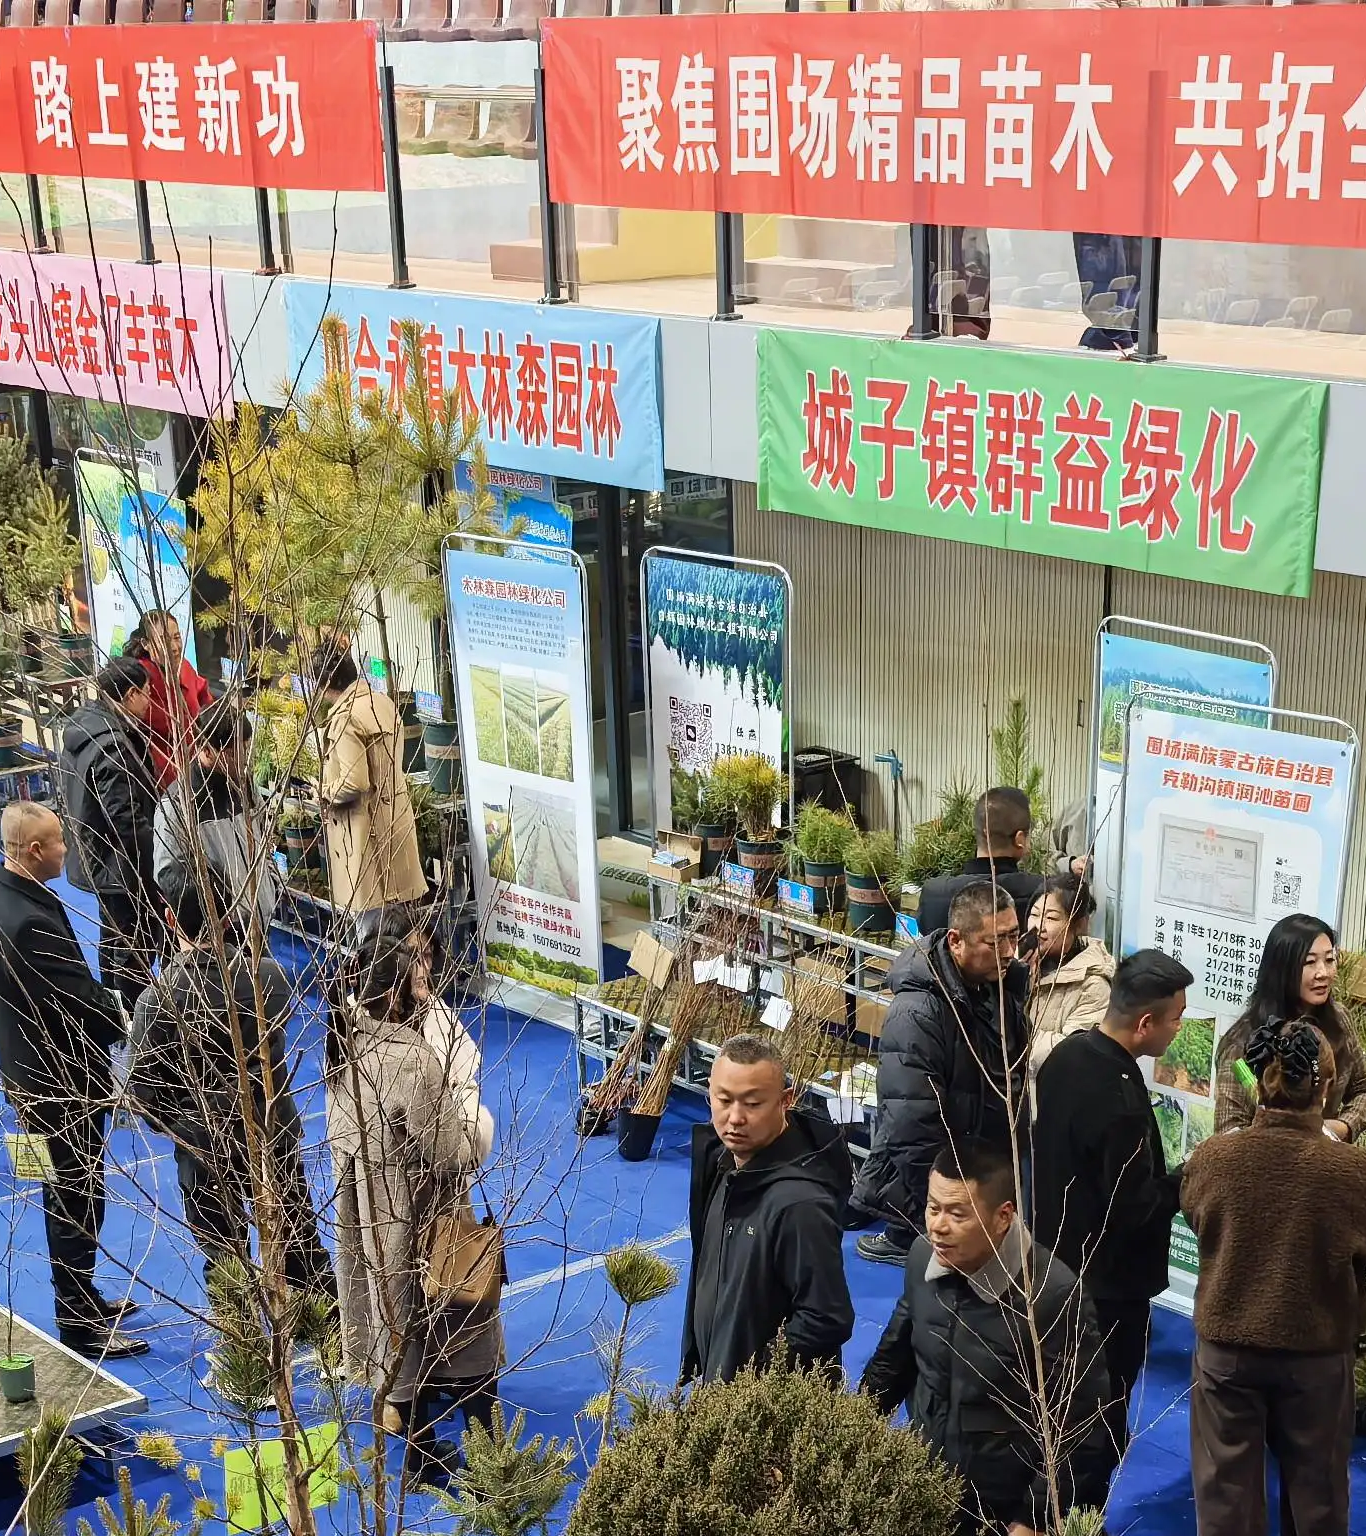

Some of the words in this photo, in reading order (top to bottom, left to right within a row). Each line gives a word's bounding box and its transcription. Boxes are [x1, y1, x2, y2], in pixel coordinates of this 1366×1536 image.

[31, 56, 307, 158] 路上建新功
[616, 52, 1116, 190] 聚焦围场精品苗木
[801, 367, 1260, 555] 城子镇群益绿化
[461, 576, 568, 610] 木林森园林绿化公司
[1146, 736, 1334, 787] 围场满族蒙古族自治县
[1161, 768, 1314, 814] 克勒沟镇润沁苗圃
[1206, 943, 1246, 963] 16/20杯
[1207, 928, 1246, 947] 12/18杯
[1205, 972, 1244, 992] 21/21杯
[1206, 958, 1245, 977] 21/21杯
[1204, 987, 1243, 1007] 12/18杯
